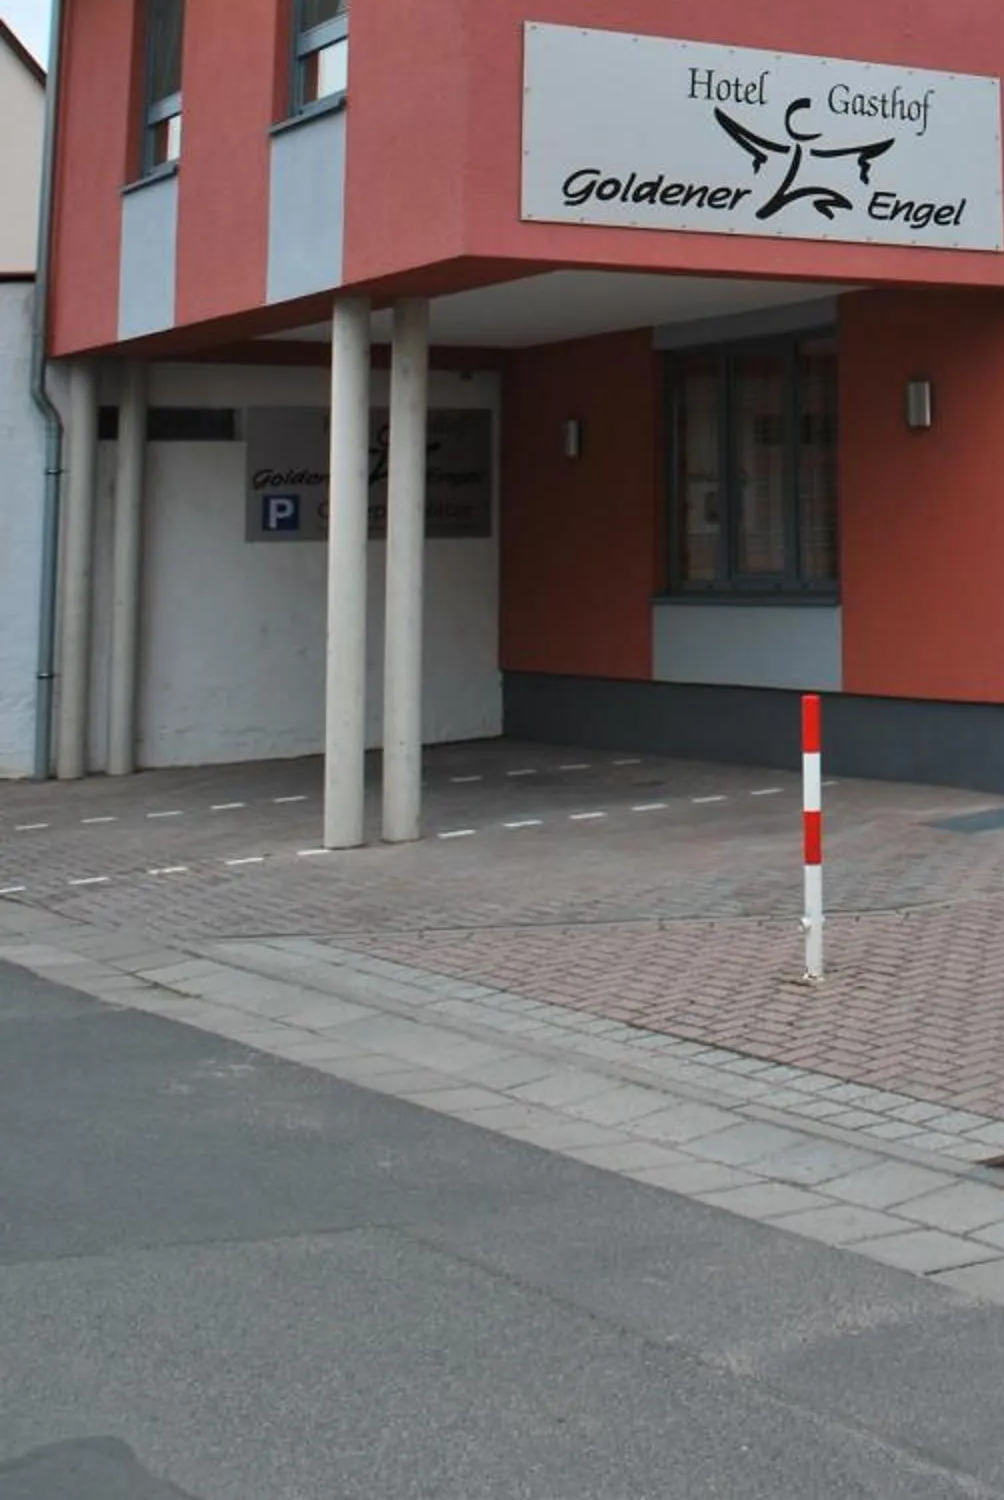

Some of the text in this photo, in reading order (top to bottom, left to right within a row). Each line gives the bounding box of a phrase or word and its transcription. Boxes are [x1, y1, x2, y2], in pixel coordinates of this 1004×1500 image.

[688, 67, 935, 135] Hotel Gasthof
[562, 169, 967, 229] Goldener Engel
[268, 498, 295, 529] P
